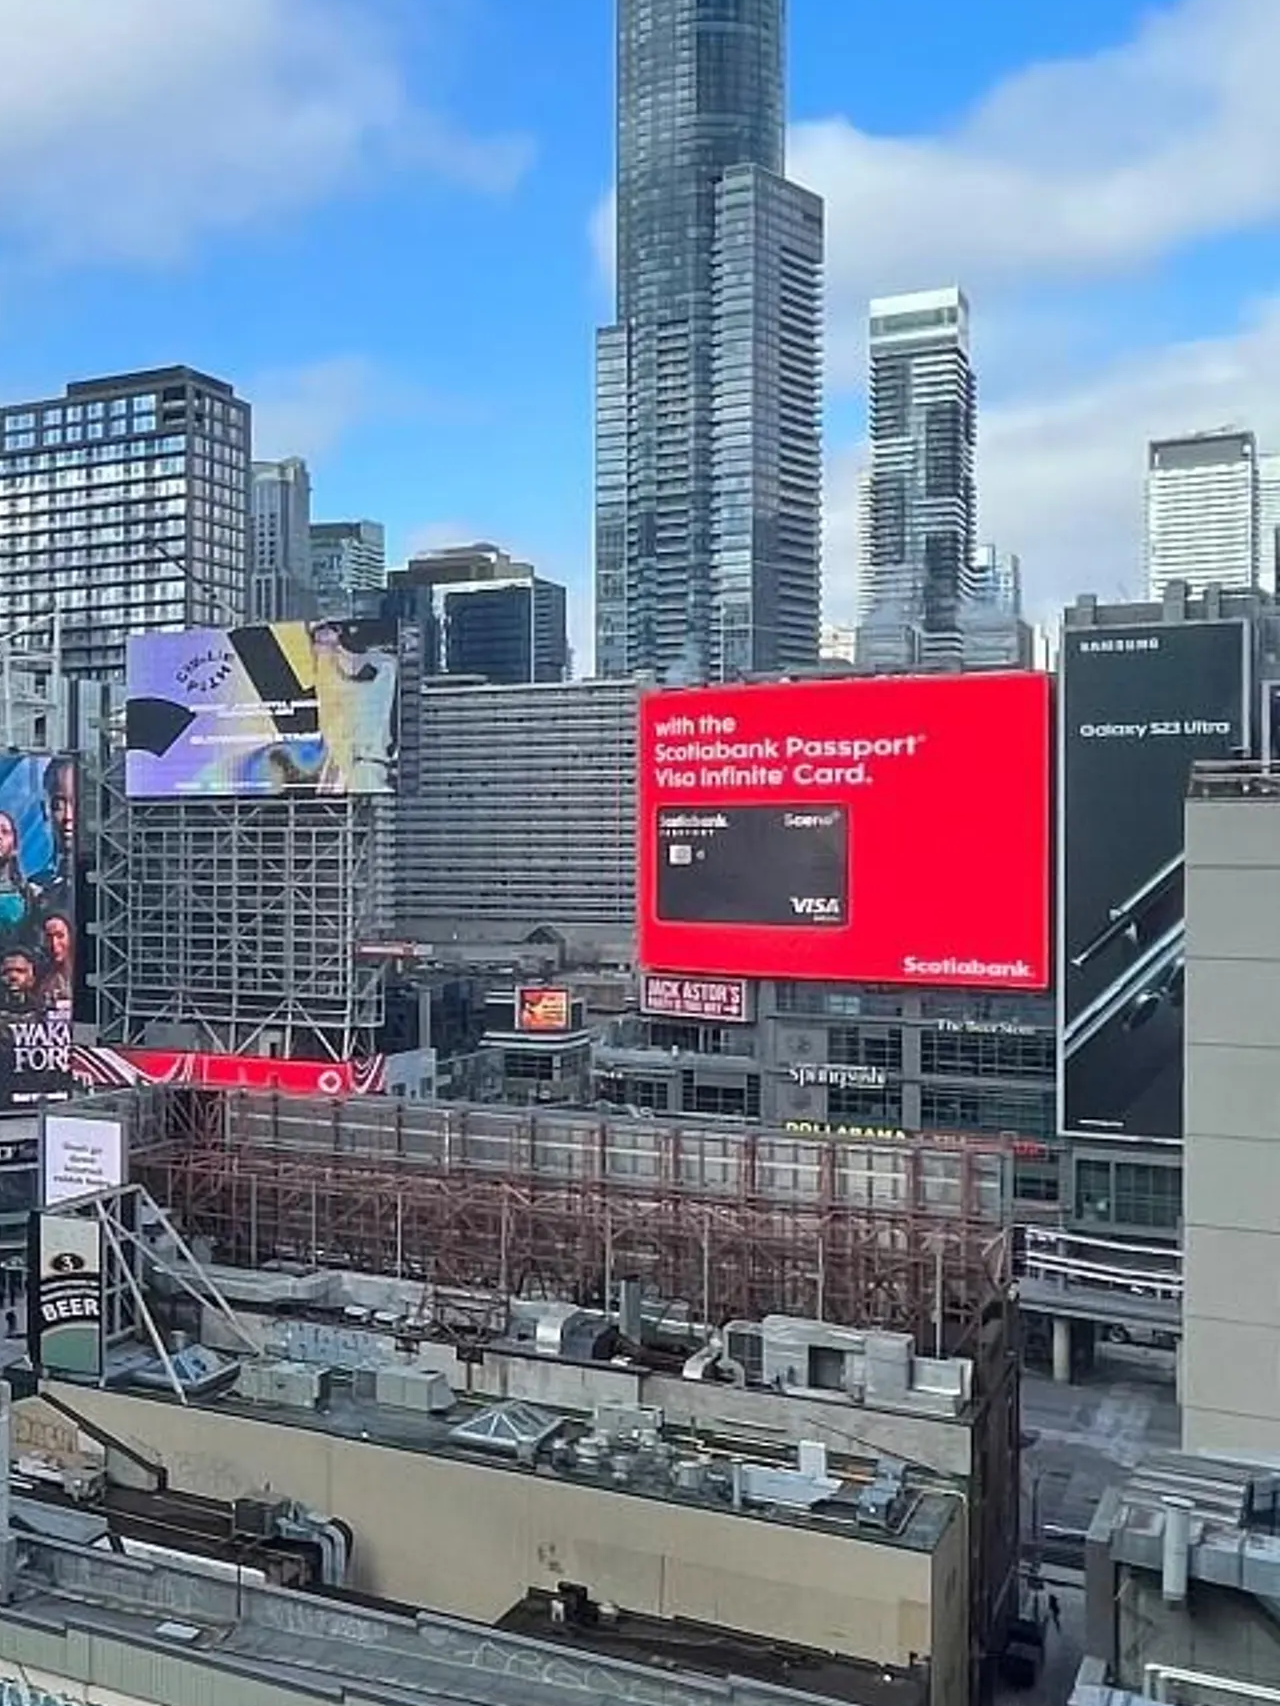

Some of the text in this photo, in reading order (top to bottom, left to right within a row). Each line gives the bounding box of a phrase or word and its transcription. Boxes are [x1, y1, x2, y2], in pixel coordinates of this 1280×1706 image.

[655, 714, 737, 737] with the
[1080, 722, 1148, 738] Galaxy
[1184, 721, 1230, 734] Ultra
[655, 739, 779, 762] Scotiabank
[655, 767, 697, 787] Visa
[793, 763, 873, 786] Card.
[790, 897, 840, 914] VISA
[903, 956, 1031, 977] Scotiabank
[41, 1298, 100, 1322] BEER
